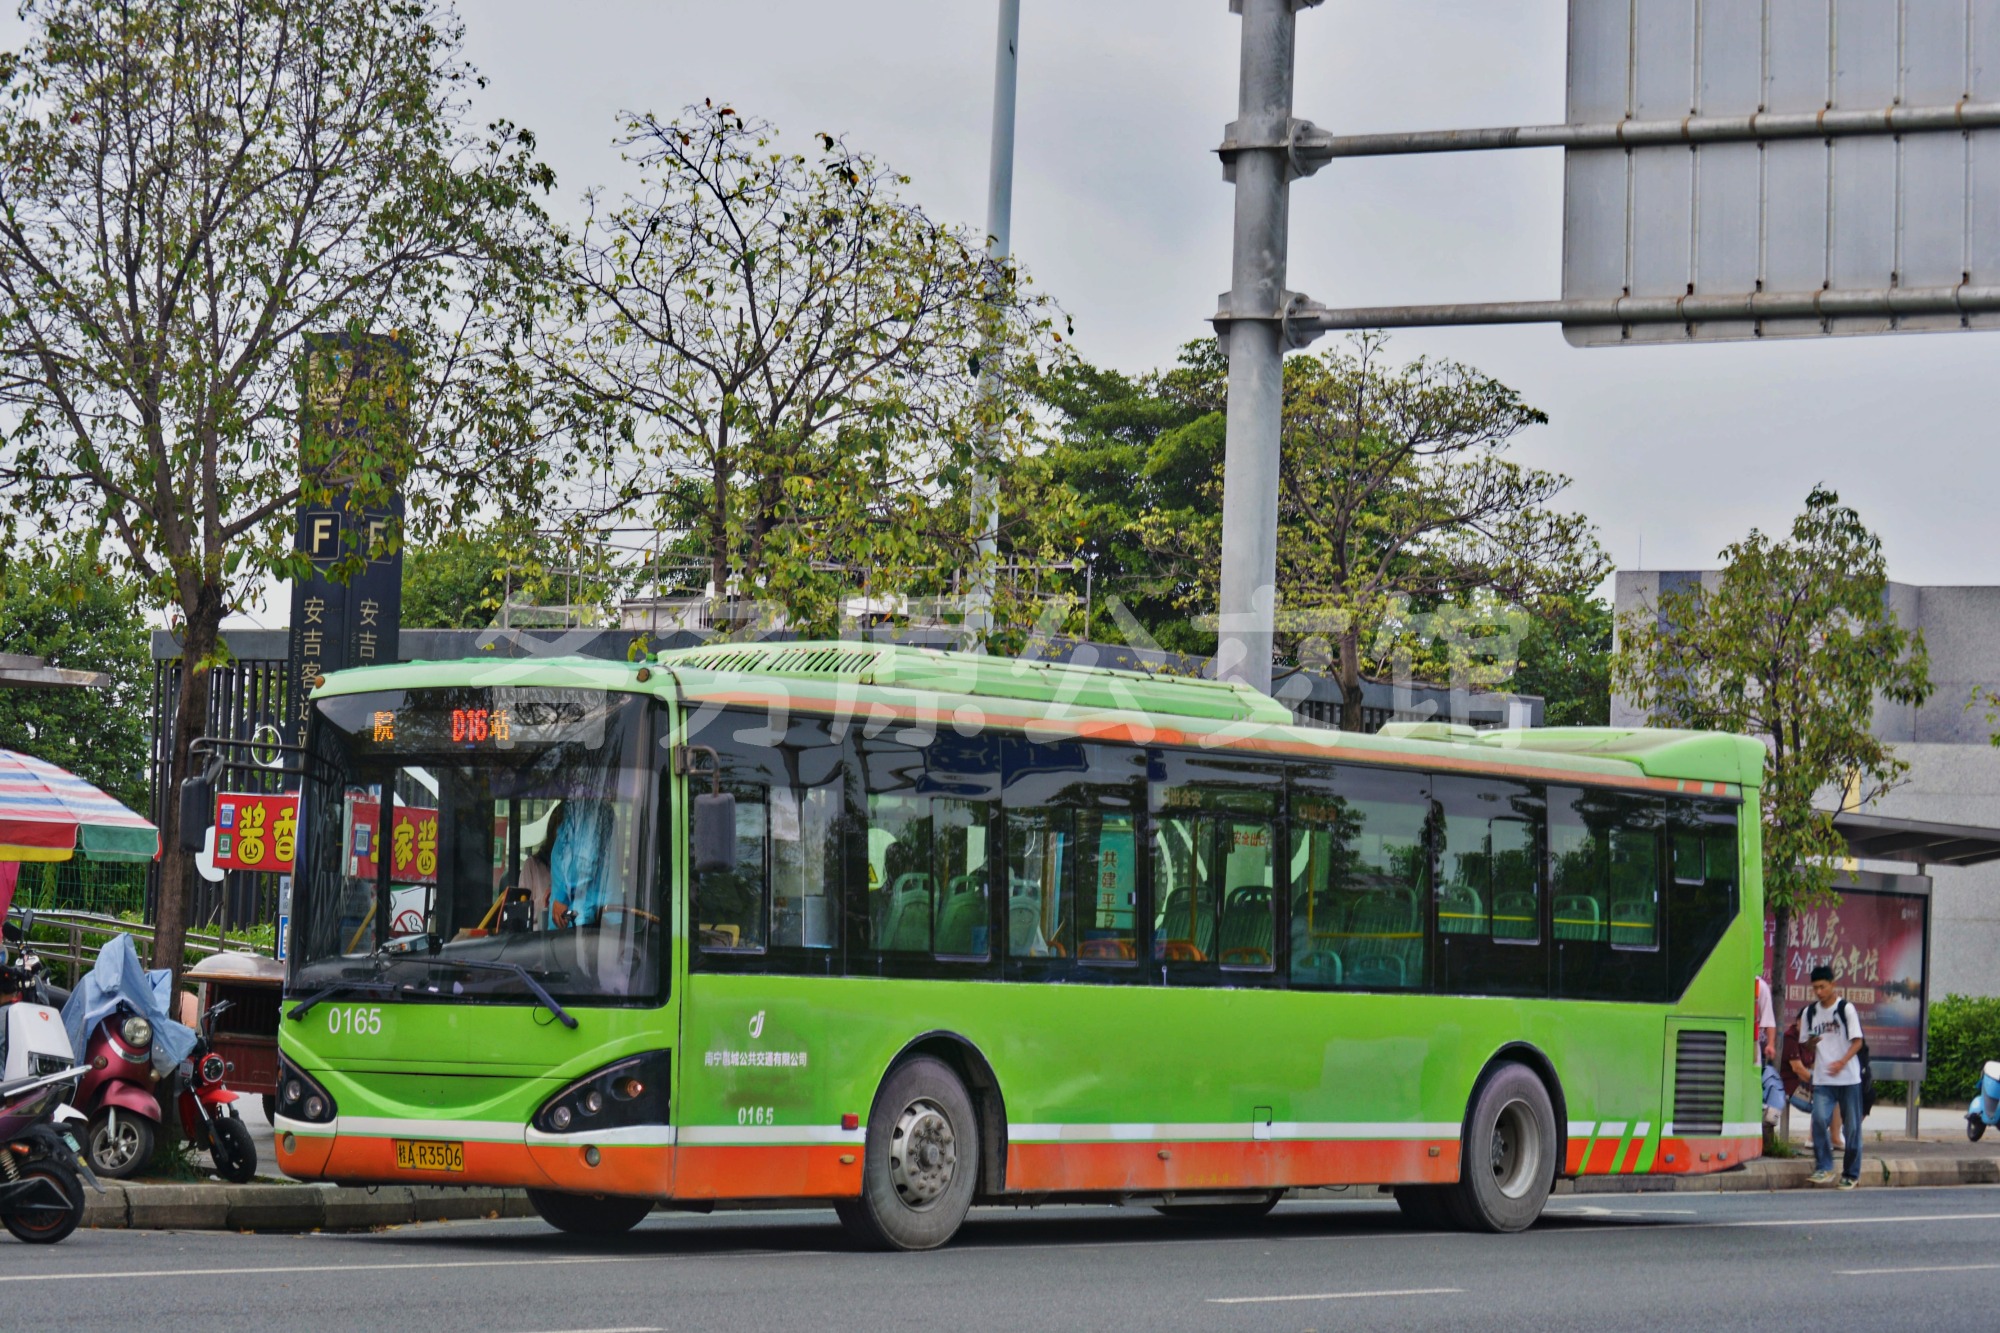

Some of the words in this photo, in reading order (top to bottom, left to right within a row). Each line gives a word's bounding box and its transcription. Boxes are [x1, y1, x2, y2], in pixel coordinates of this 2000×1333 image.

[313, 518, 333, 554] F
[359, 598, 379, 667] 安吉
[373, 710, 395, 742] 院
[452, 709, 489, 742] D16
[489, 709, 511, 742] 站
[237, 801, 297, 865] 酱香
[328, 1007, 381, 1035] 0165
[738, 1106, 774, 1125] 0165
